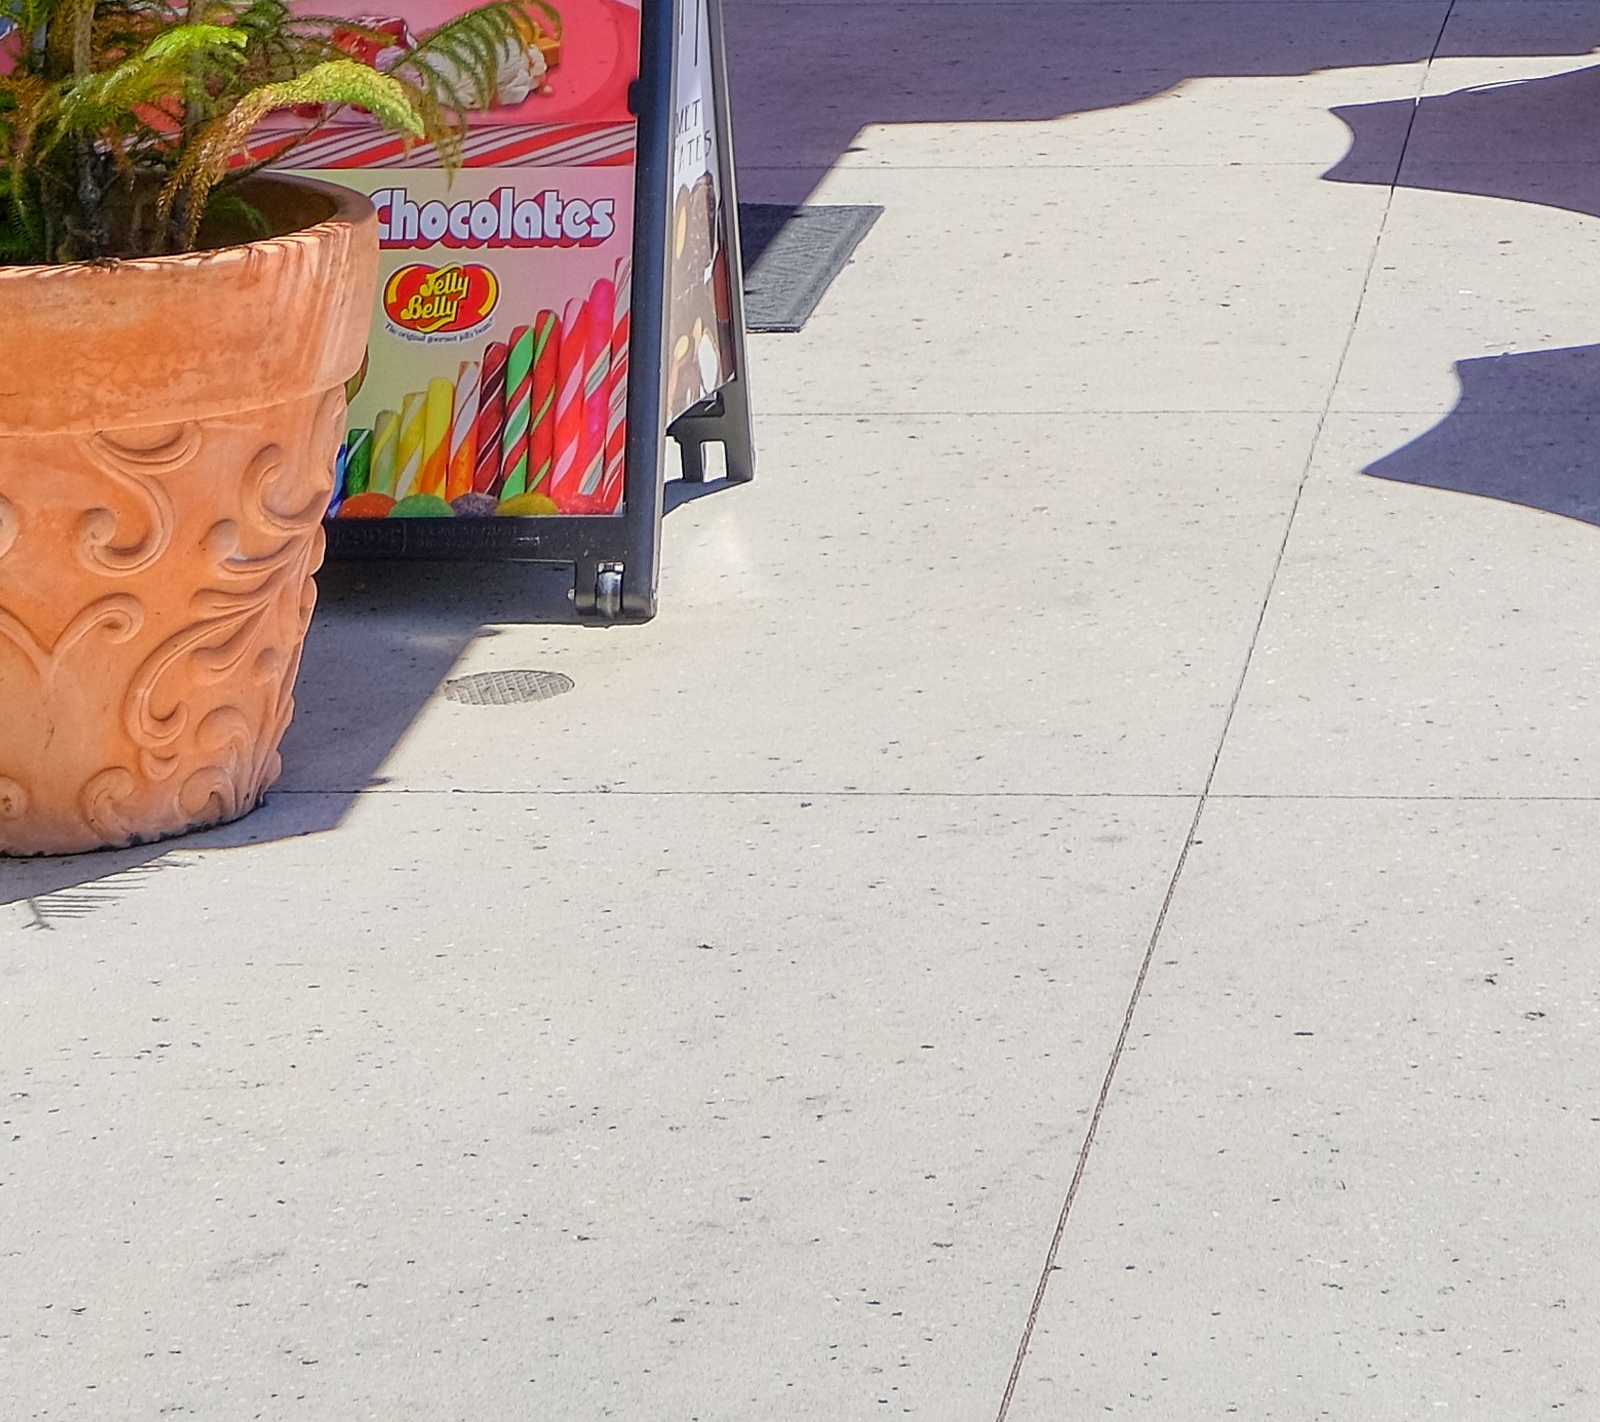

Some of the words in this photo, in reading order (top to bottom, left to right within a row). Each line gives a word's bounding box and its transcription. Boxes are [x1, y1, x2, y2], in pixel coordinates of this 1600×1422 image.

[373, 187, 616, 248] Chocolates
[420, 272, 469, 300] Jelly
[401, 294, 458, 324] Belly
